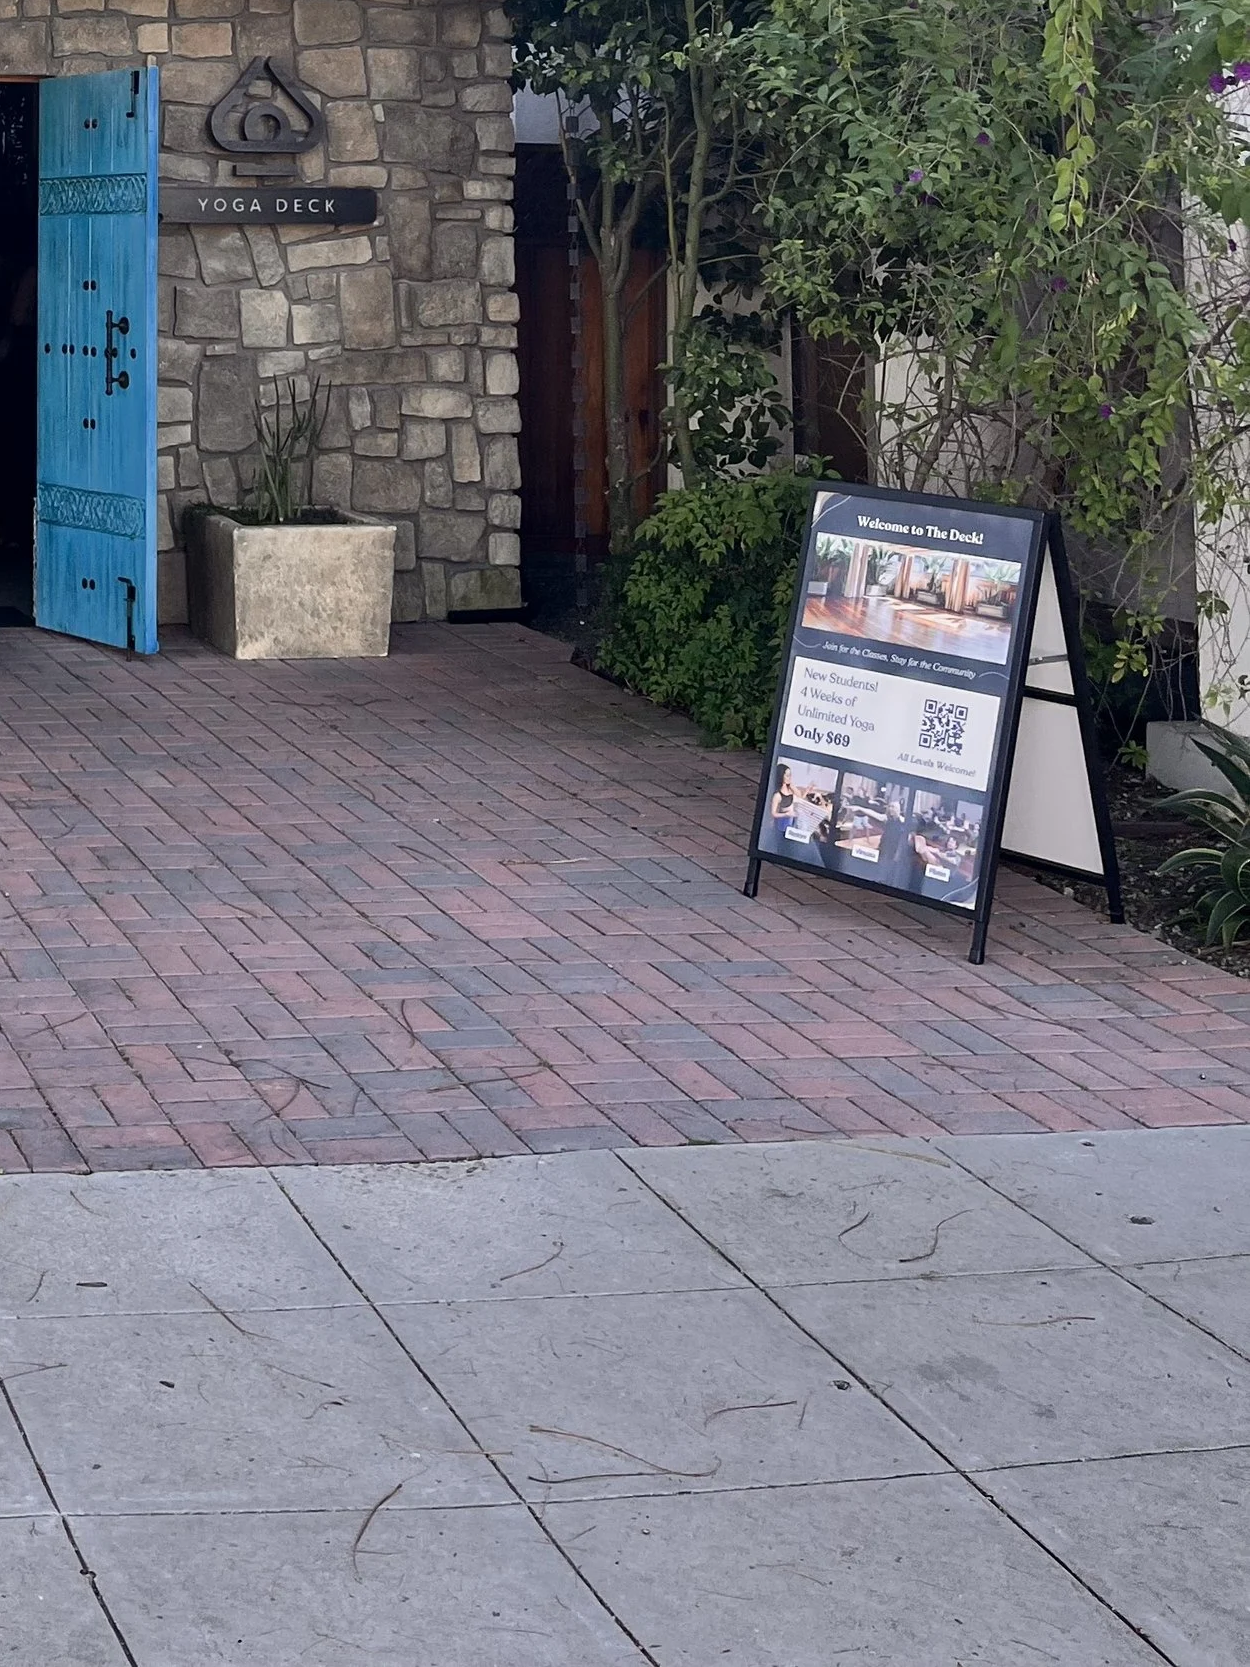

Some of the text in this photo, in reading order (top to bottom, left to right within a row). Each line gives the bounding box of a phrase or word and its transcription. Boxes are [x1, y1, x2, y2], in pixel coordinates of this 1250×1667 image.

[198, 198, 335, 213] YOGA DECK
[857, 515, 984, 545] Welcome to The Deck!
[822, 641, 976, 680] Join for the Classes, Stay for the Community
[804, 667, 879, 692] New Students!
[800, 686, 858, 707] 4 Weeks of
[797, 704, 875, 732] Unlimited Yoga
[794, 724, 850, 747] Only $69
[897, 752, 976, 777] All Levels Welcome!
